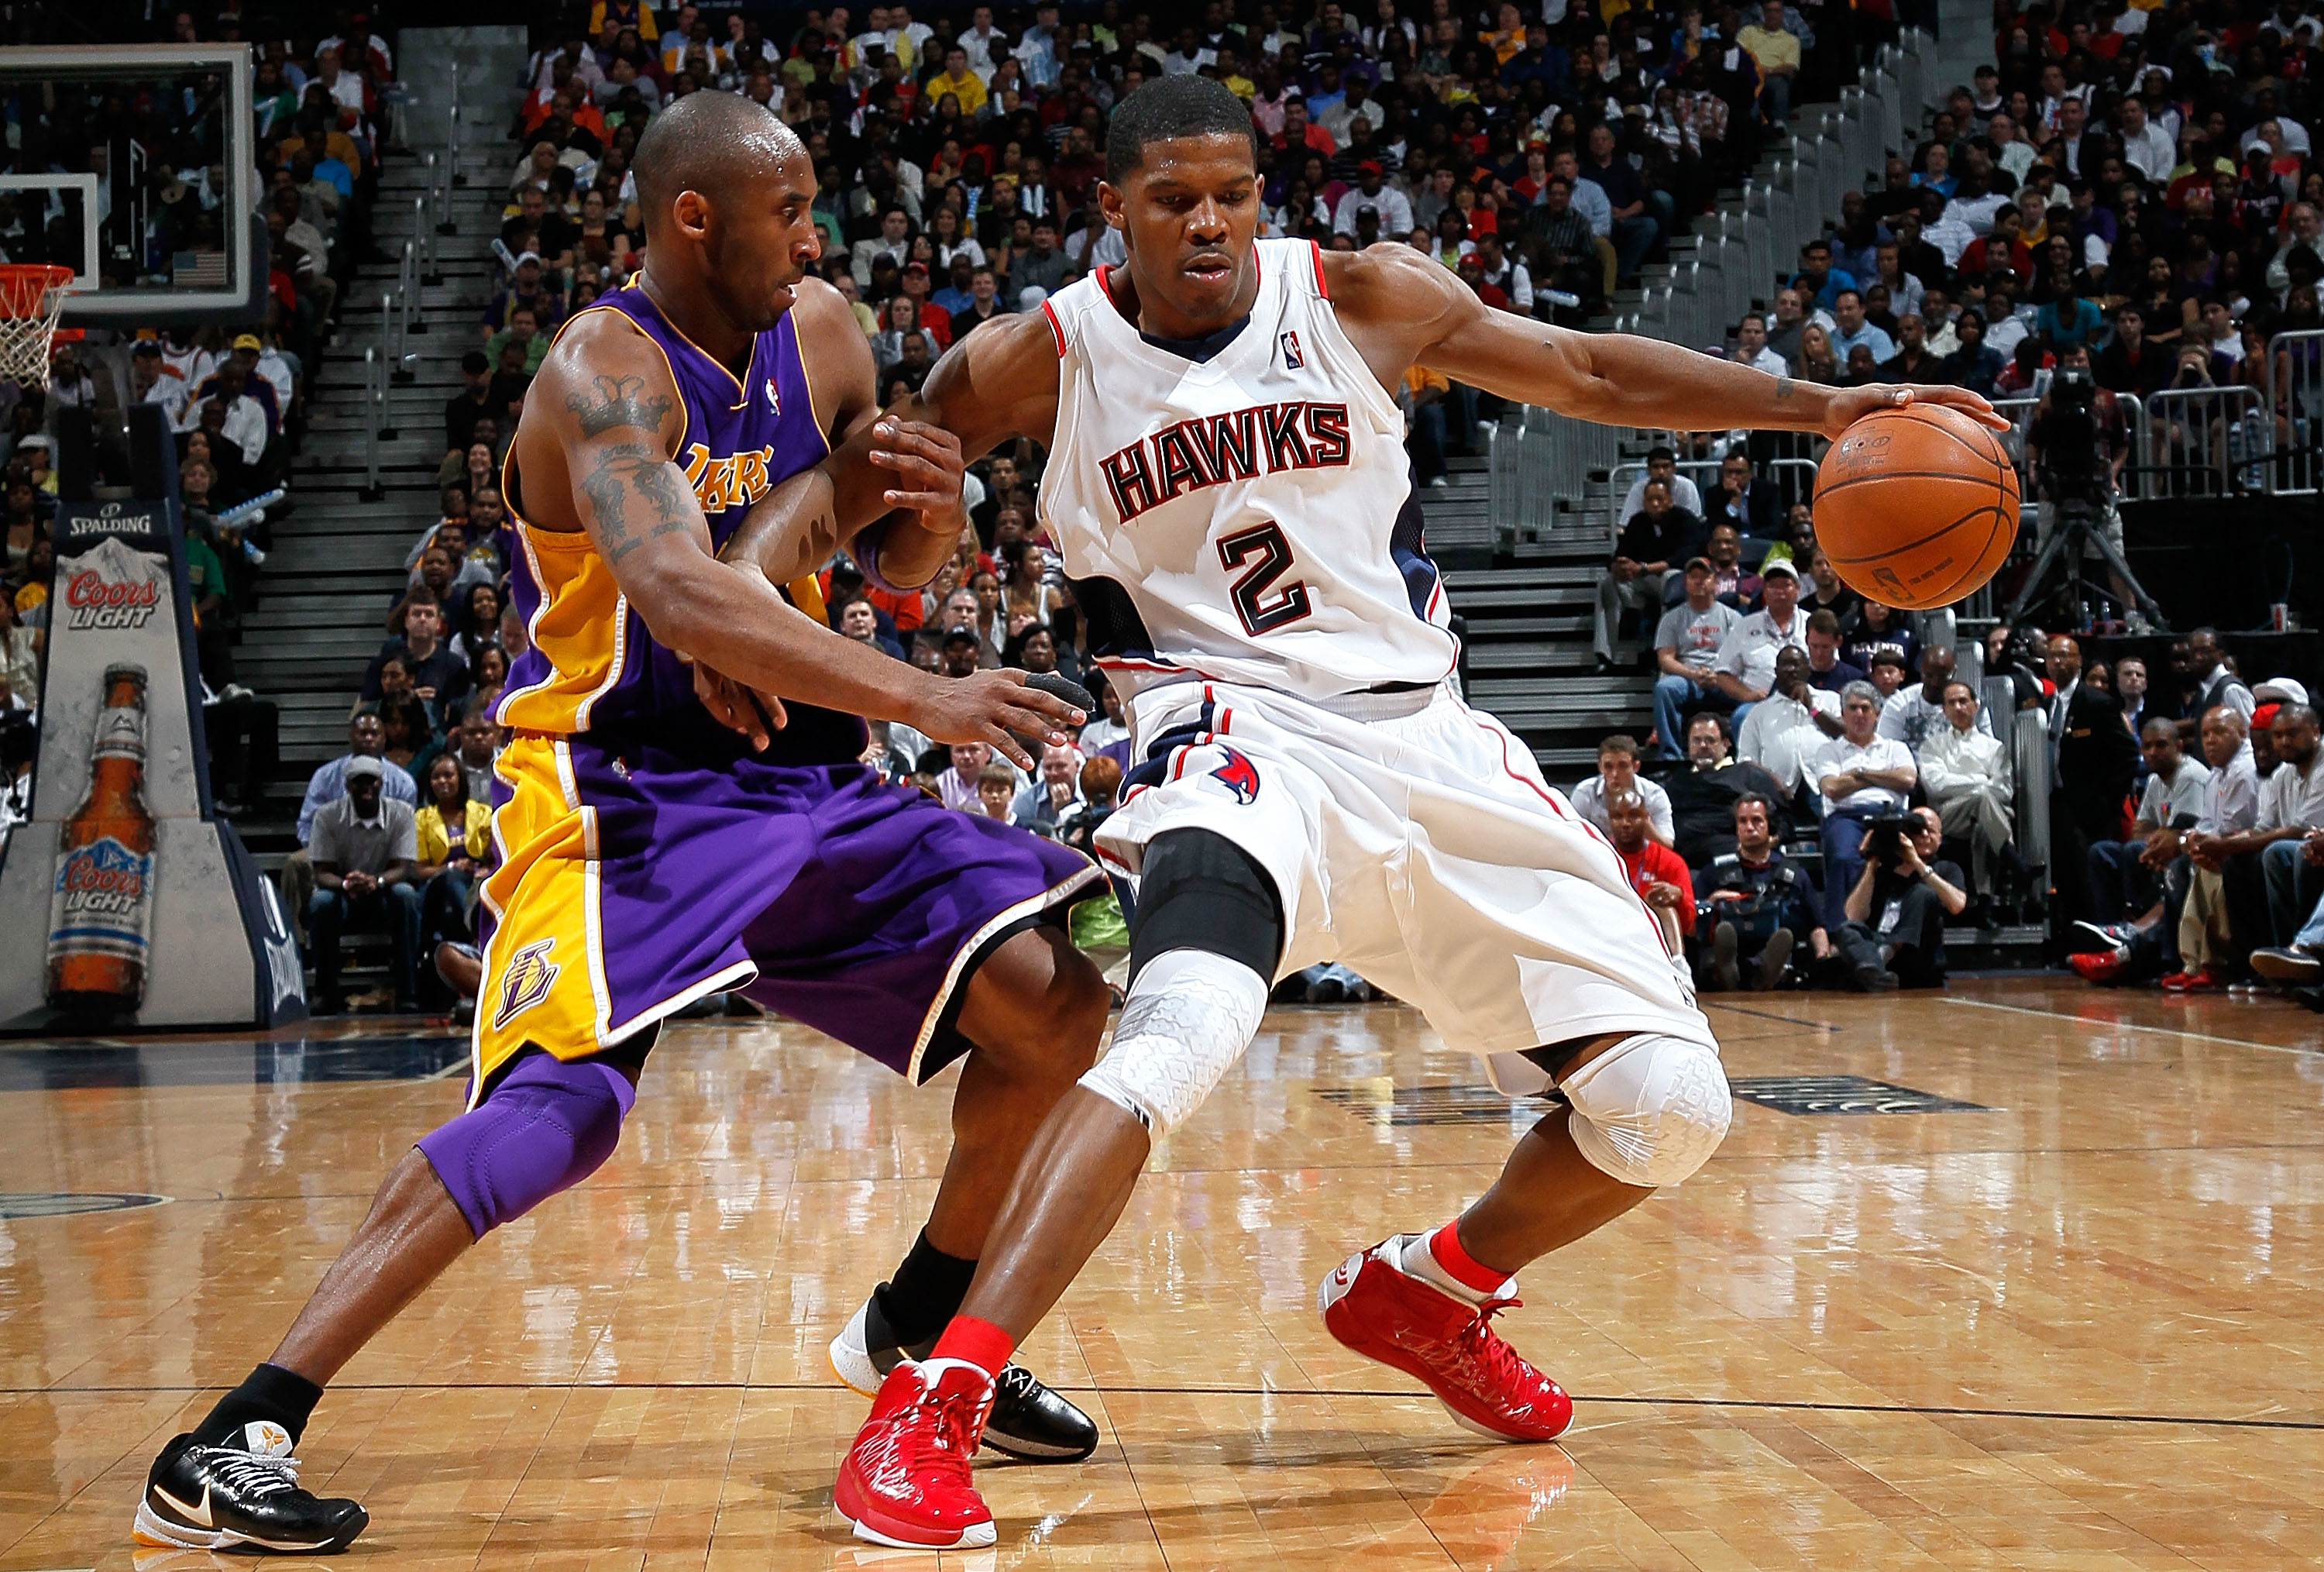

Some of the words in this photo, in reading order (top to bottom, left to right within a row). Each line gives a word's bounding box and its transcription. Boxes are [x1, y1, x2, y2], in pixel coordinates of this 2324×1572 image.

[1098, 401, 1351, 525] HAWKS
[70, 514, 151, 535] SPALDING
[67, 567, 159, 607] Coors
[1216, 520, 1312, 637] 2
[68, 607, 156, 630] LIGHT
[65, 855, 141, 896] Coors
[64, 891, 137, 914] LIGHT
